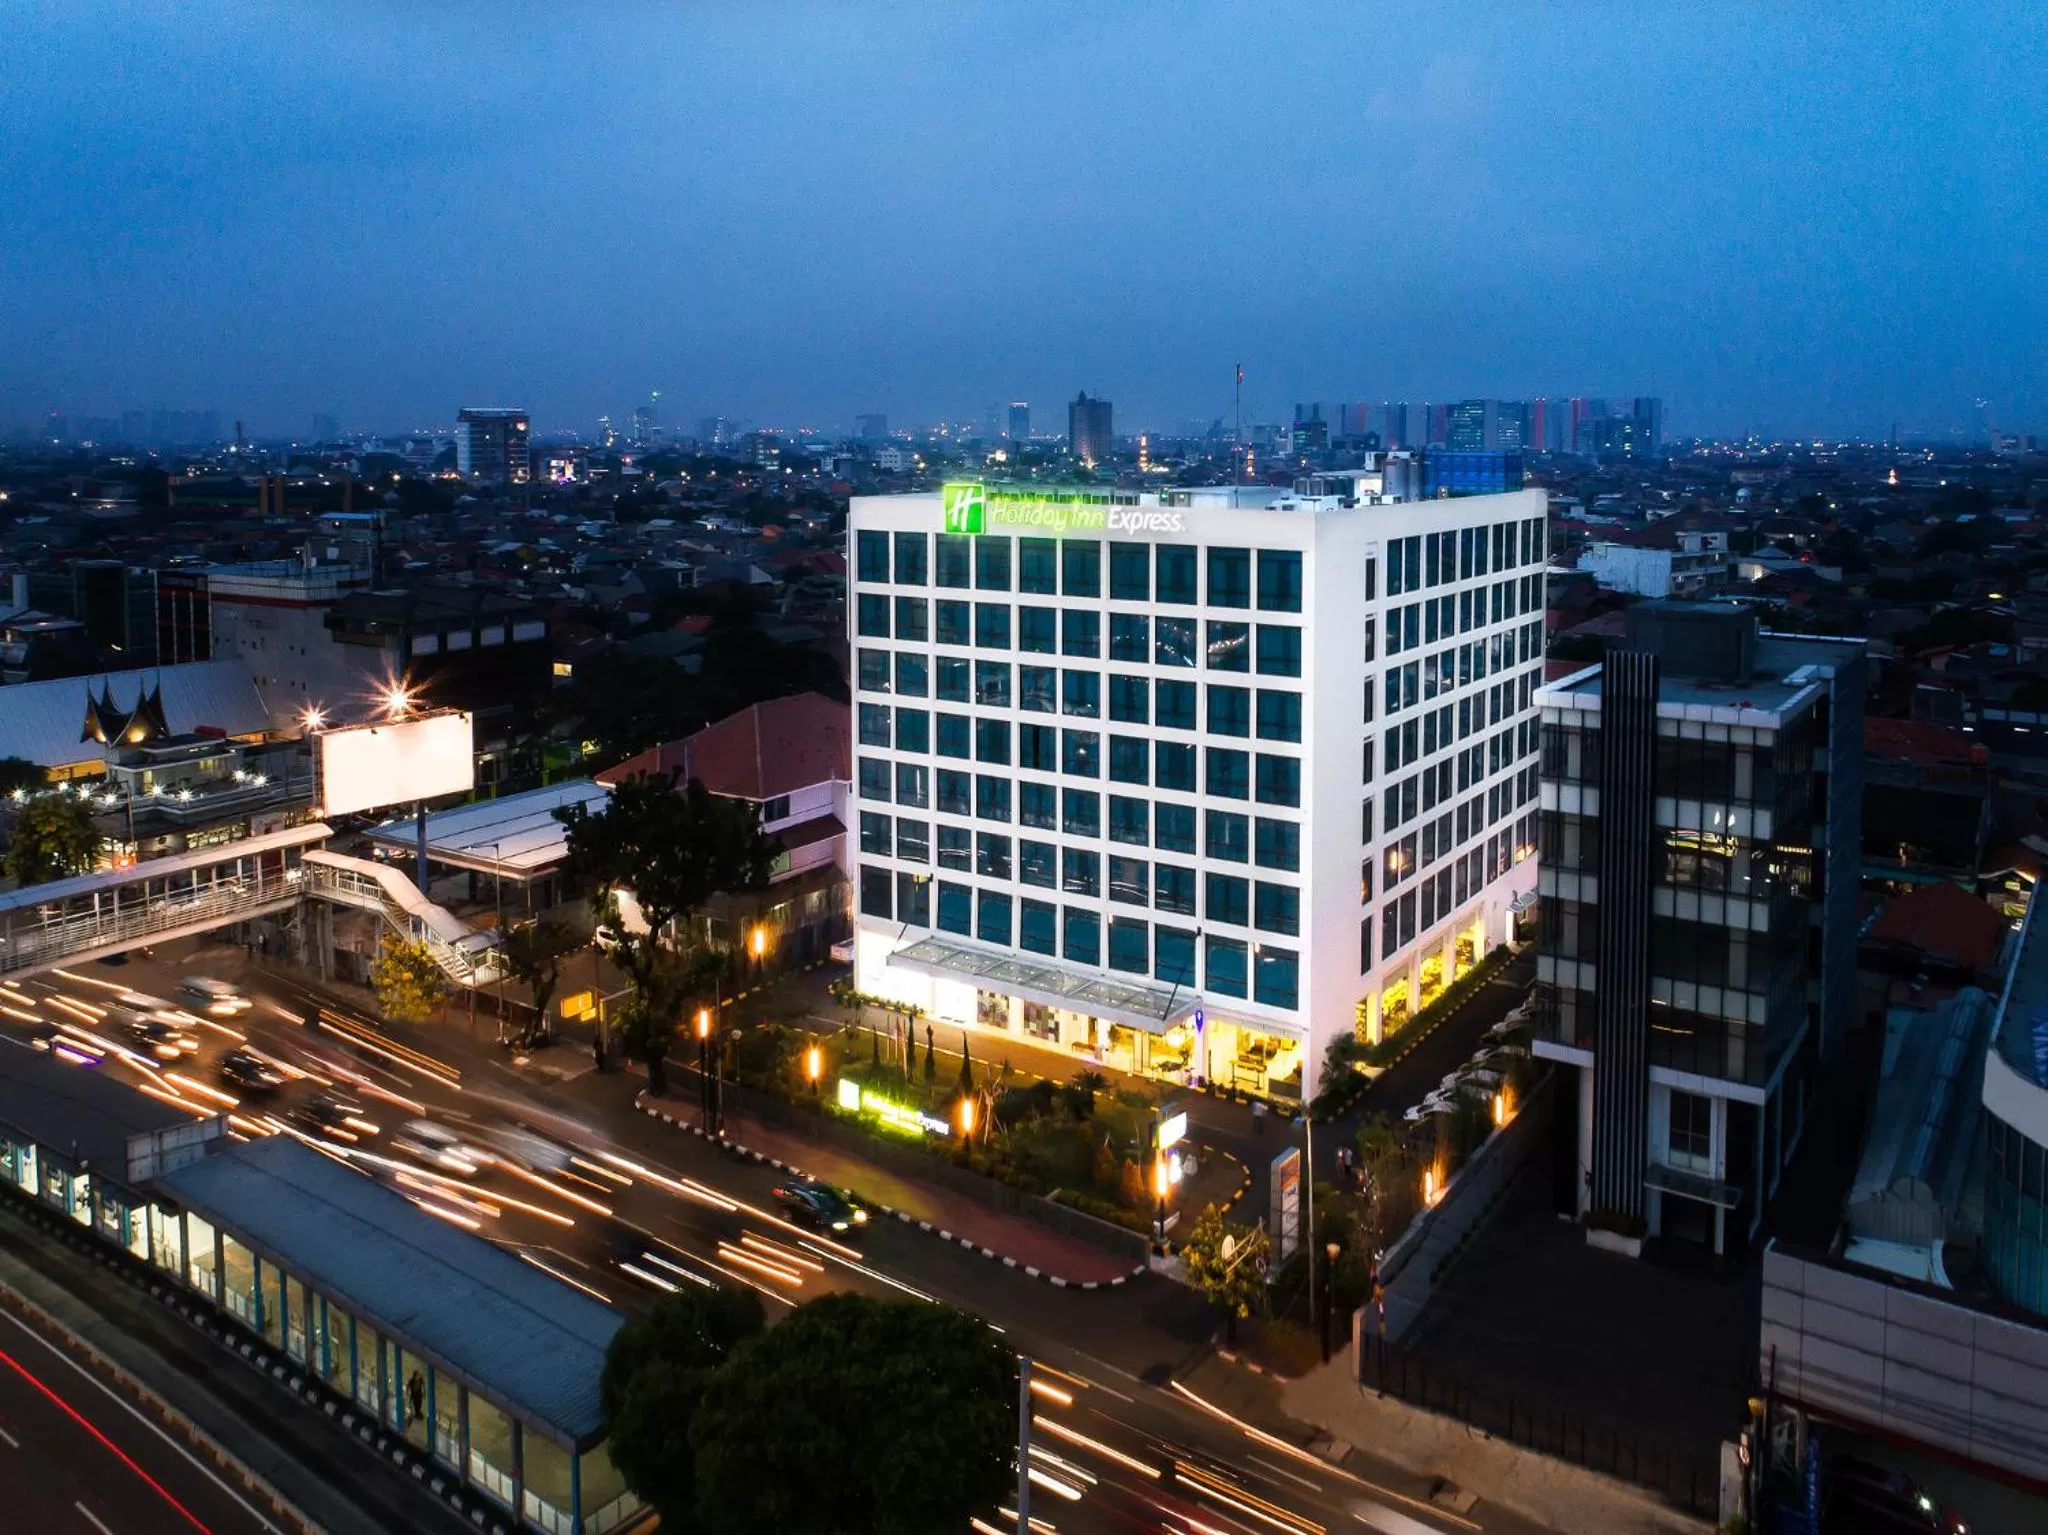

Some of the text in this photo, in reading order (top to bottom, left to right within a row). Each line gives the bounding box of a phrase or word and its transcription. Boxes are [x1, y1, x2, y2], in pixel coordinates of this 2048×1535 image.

[991, 499, 1182, 535] Holiday Inn Express
